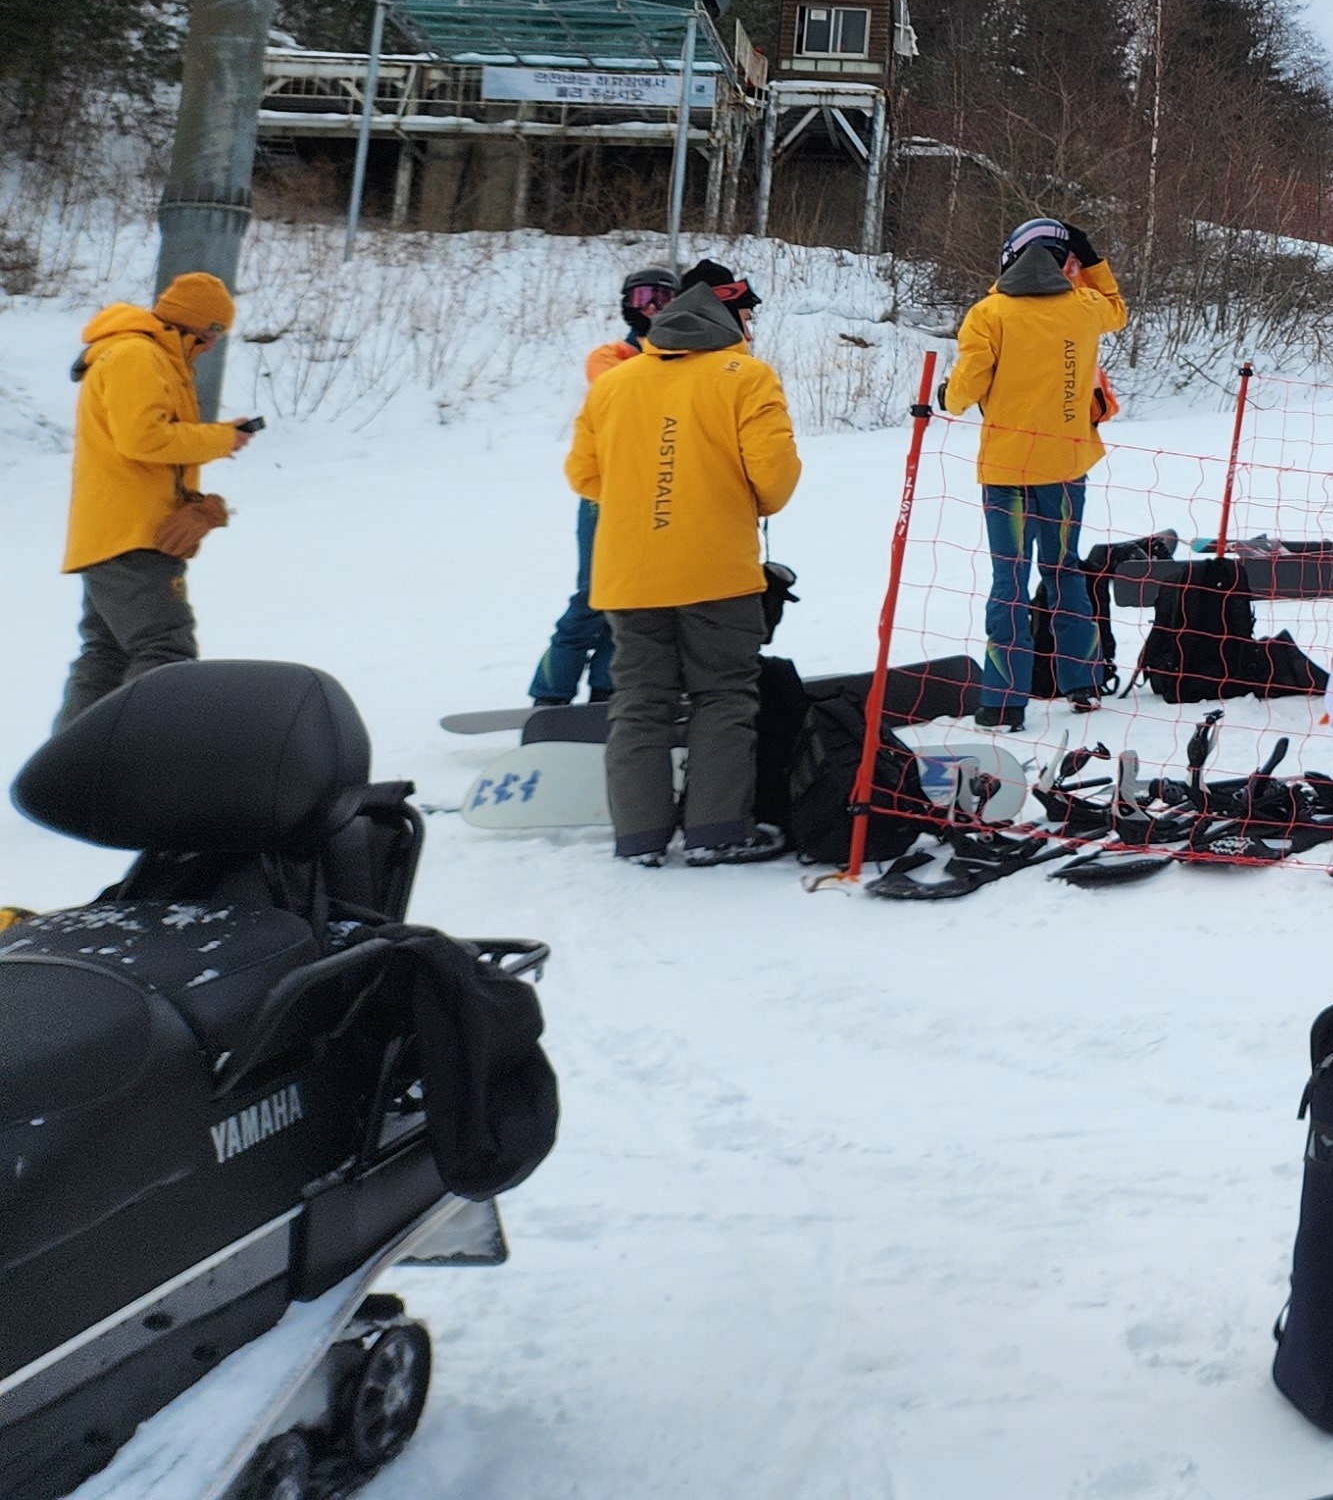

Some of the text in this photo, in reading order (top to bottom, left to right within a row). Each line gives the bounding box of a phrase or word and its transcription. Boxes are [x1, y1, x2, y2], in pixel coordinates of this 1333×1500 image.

[1063, 339, 1076, 424] AUSTRALIA
[652, 415, 678, 532] AUSTRALIA
[898, 475, 913, 536] LISKI
[210, 1083, 304, 1163] YAMAHA
